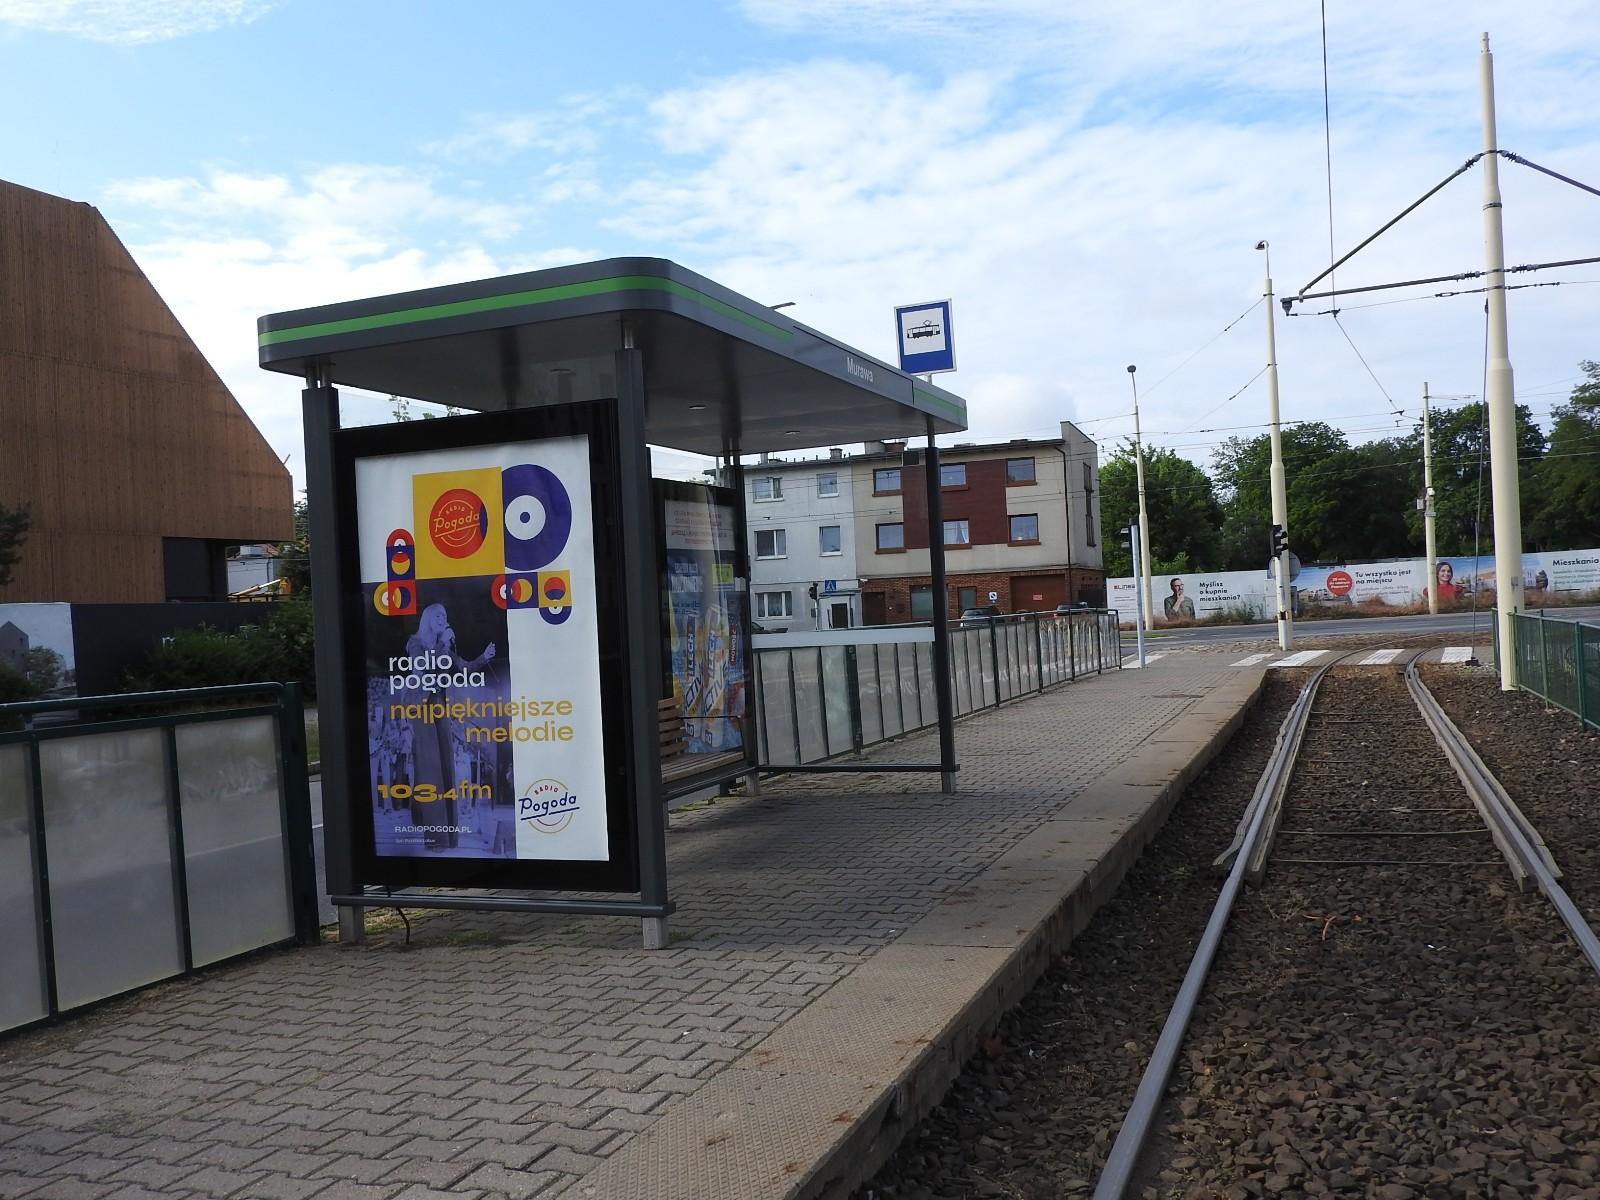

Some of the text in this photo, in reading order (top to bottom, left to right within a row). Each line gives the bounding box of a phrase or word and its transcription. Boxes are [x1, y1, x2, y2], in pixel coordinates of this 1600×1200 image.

[847, 357, 874, 383] Murawa
[433, 510, 480, 533] Pogoda
[1552, 557, 1599, 567] Mieszkania
[1365, 569, 1397, 578] wszystko
[1366, 577, 1393, 585] miejscu
[388, 650, 453, 672] radio
[389, 667, 486, 695] pogoda
[389, 696, 573, 722] najpiękniejsze
[466, 720, 574, 743] melodie
[534, 785, 559, 796] RADIO
[518, 792, 577, 817] Pogoda
[394, 825, 472, 833] RADIOPOGODA.PL
